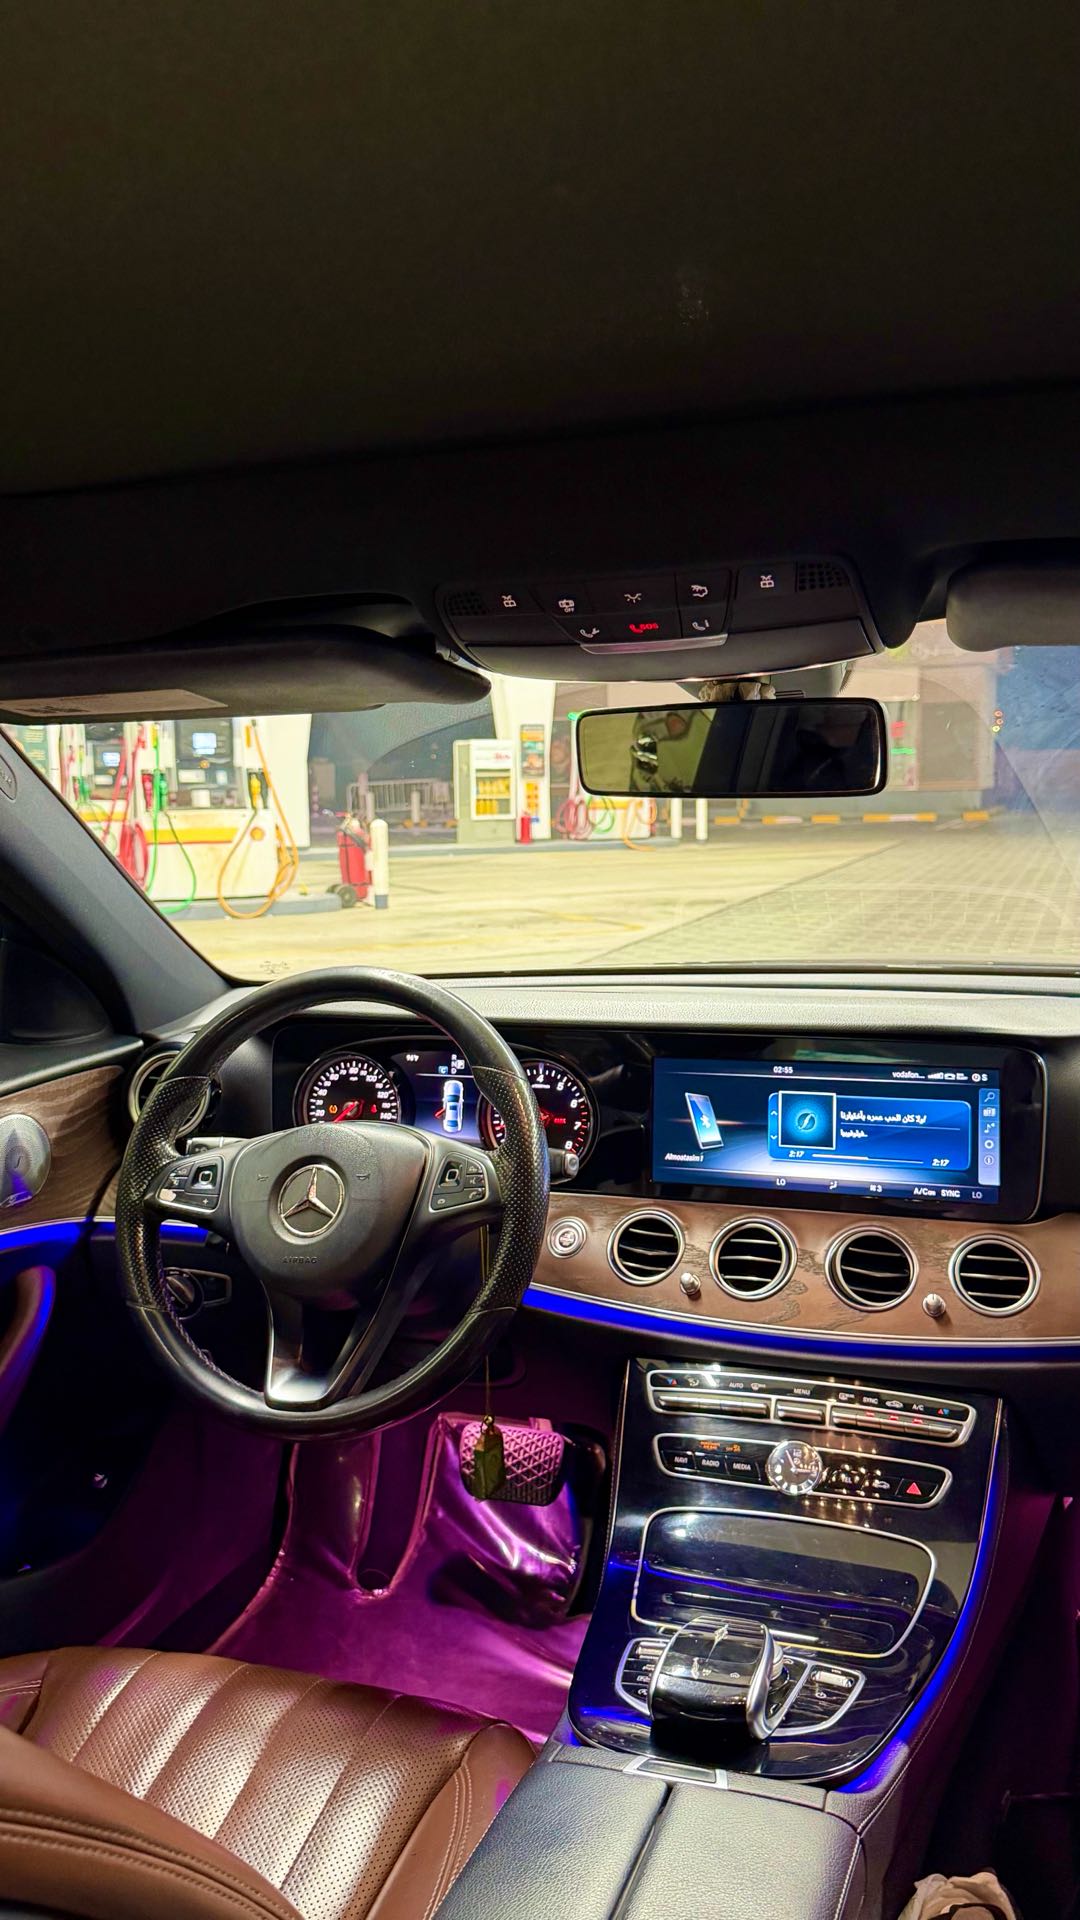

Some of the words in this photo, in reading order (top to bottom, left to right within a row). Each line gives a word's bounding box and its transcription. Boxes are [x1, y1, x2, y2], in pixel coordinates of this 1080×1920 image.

[640, 622, 659, 630] SOS
[773, 1066, 793, 1074] 02:55
[536, 1074, 544, 1082] 4
[556, 1081, 564, 1091] 5
[570, 1099, 578, 1108] 6
[315, 1109, 325, 1117] 20
[573, 1121, 581, 1130] 7
[565, 1140, 573, 1150] 8
[788, 1150, 805, 1158] 2:17
[931, 1158, 950, 1167] 2:17
[776, 1177, 786, 1186] LO
[941, 1189, 961, 1198] SYNC
[972, 1191, 983, 1199] LO
[281, 1255, 317, 1264] AIRBAG
[793, 1388, 811, 1396] MENU
[862, 1396, 878, 1405] SYNC
[912, 1403, 924, 1411] A/C
[674, 1456, 688, 1464] NAVI
[702, 1459, 720, 1468] RADIO
[733, 1462, 752, 1471] MEDIA
